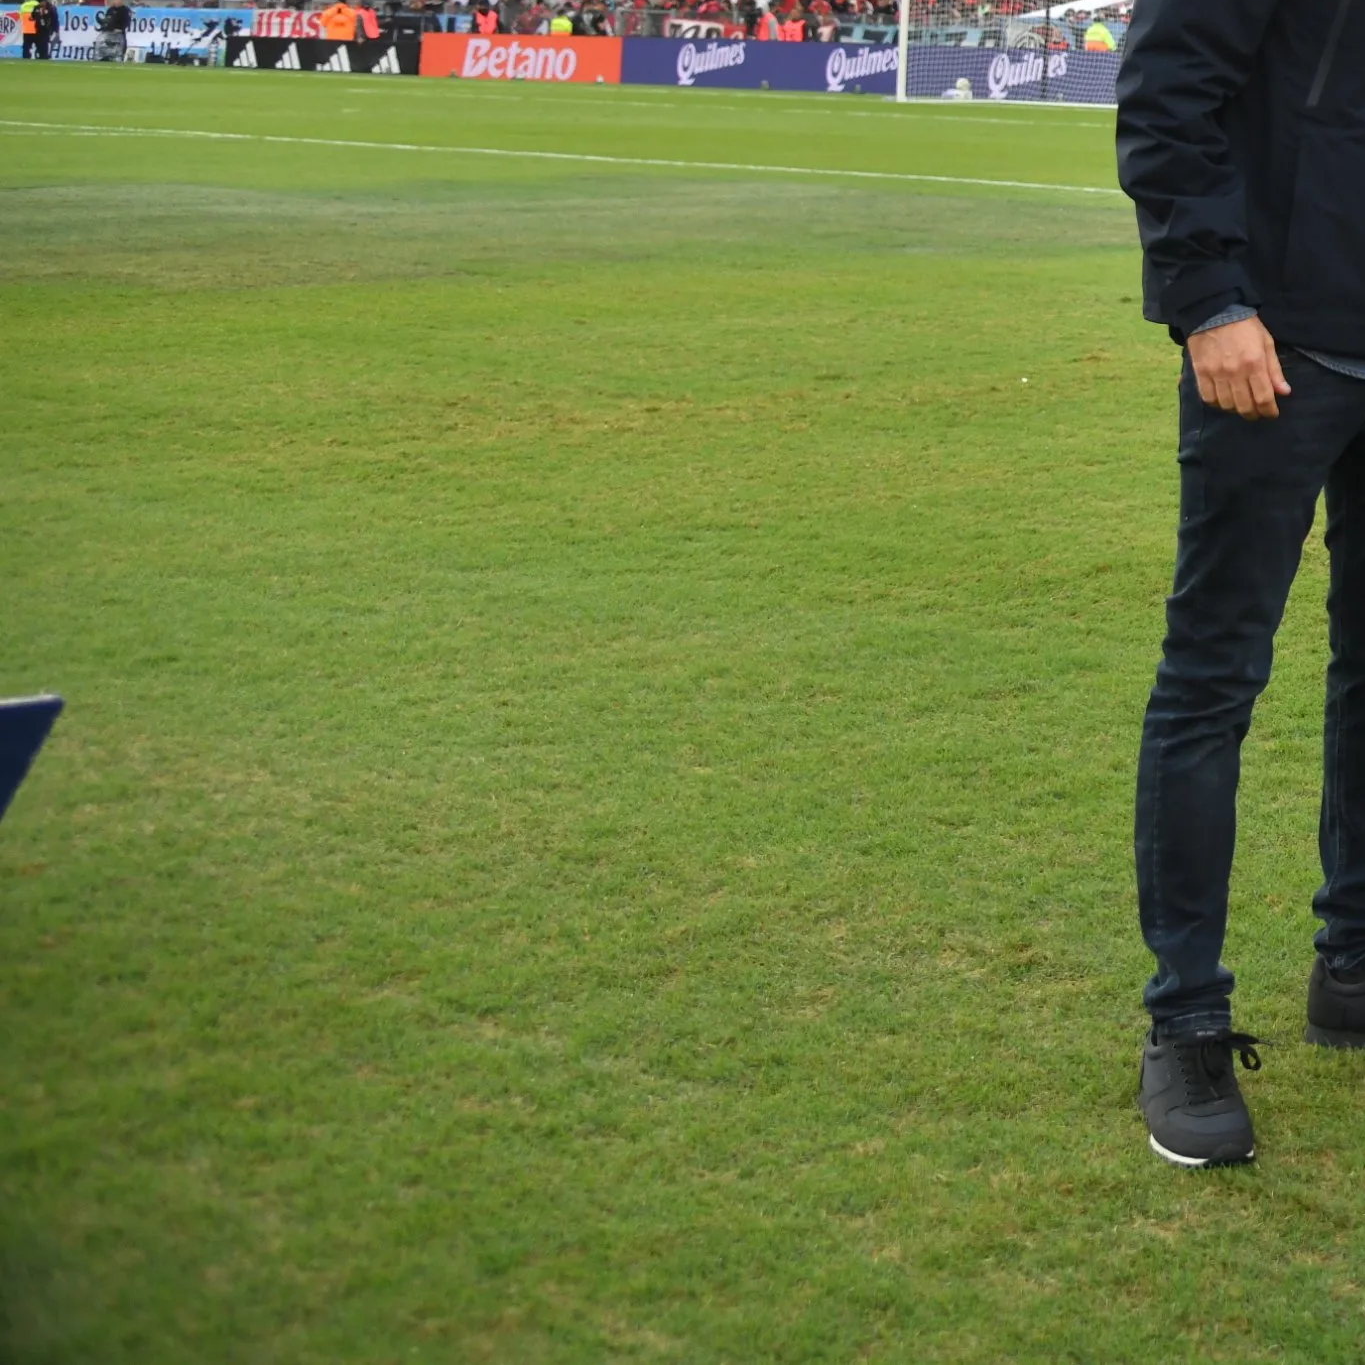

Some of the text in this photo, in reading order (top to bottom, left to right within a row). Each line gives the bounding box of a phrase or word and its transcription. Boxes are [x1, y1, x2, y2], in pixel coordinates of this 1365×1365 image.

[64, 10, 88, 32] los
[461, 38, 577, 81] Betano
[677, 42, 747, 86] Quilmes
[826, 46, 899, 92] Quilmes
